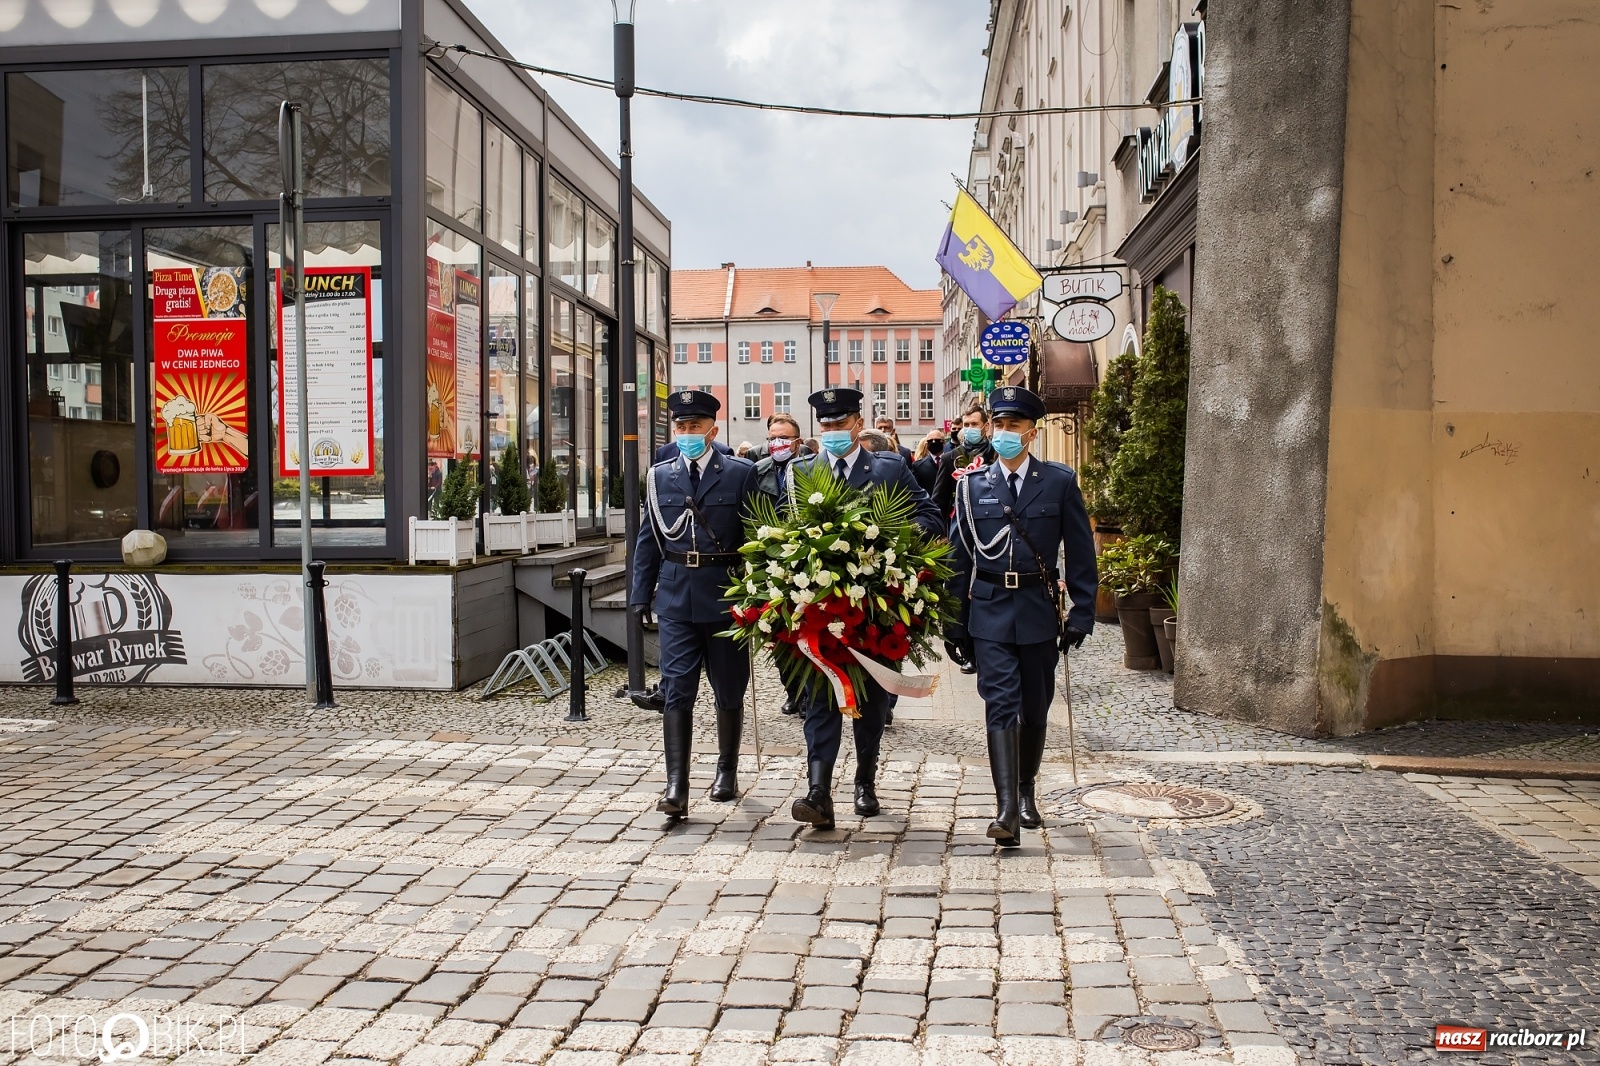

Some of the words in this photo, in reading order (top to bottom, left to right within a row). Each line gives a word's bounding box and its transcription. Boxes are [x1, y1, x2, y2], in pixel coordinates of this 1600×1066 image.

[155, 272, 172, 281] Pizza
[174, 271, 192, 281] Time
[305, 275, 355, 291] UNCH
[155, 286, 177, 299] Druga
[178, 285, 196, 298] pizza
[459, 279, 477, 297] LUNCH
[1060, 278, 1106, 296] BUTIK
[166, 297, 191, 312] gratis!
[1068, 309, 1086, 326] Art
[167, 323, 236, 346] Promocja
[1068, 325, 1096, 336] mode
[990, 338, 1024, 347] KANTOR
[178, 349, 199, 358] DWA
[201, 348, 224, 358] PIWA
[161, 360, 170, 369] W
[172, 360, 198, 368] CENIE
[200, 360, 240, 368] JEDNEGO
[36, 647, 104, 682] Brwar
[108, 633, 167, 666] Rynek
[102, 669, 126, 682] 2013
